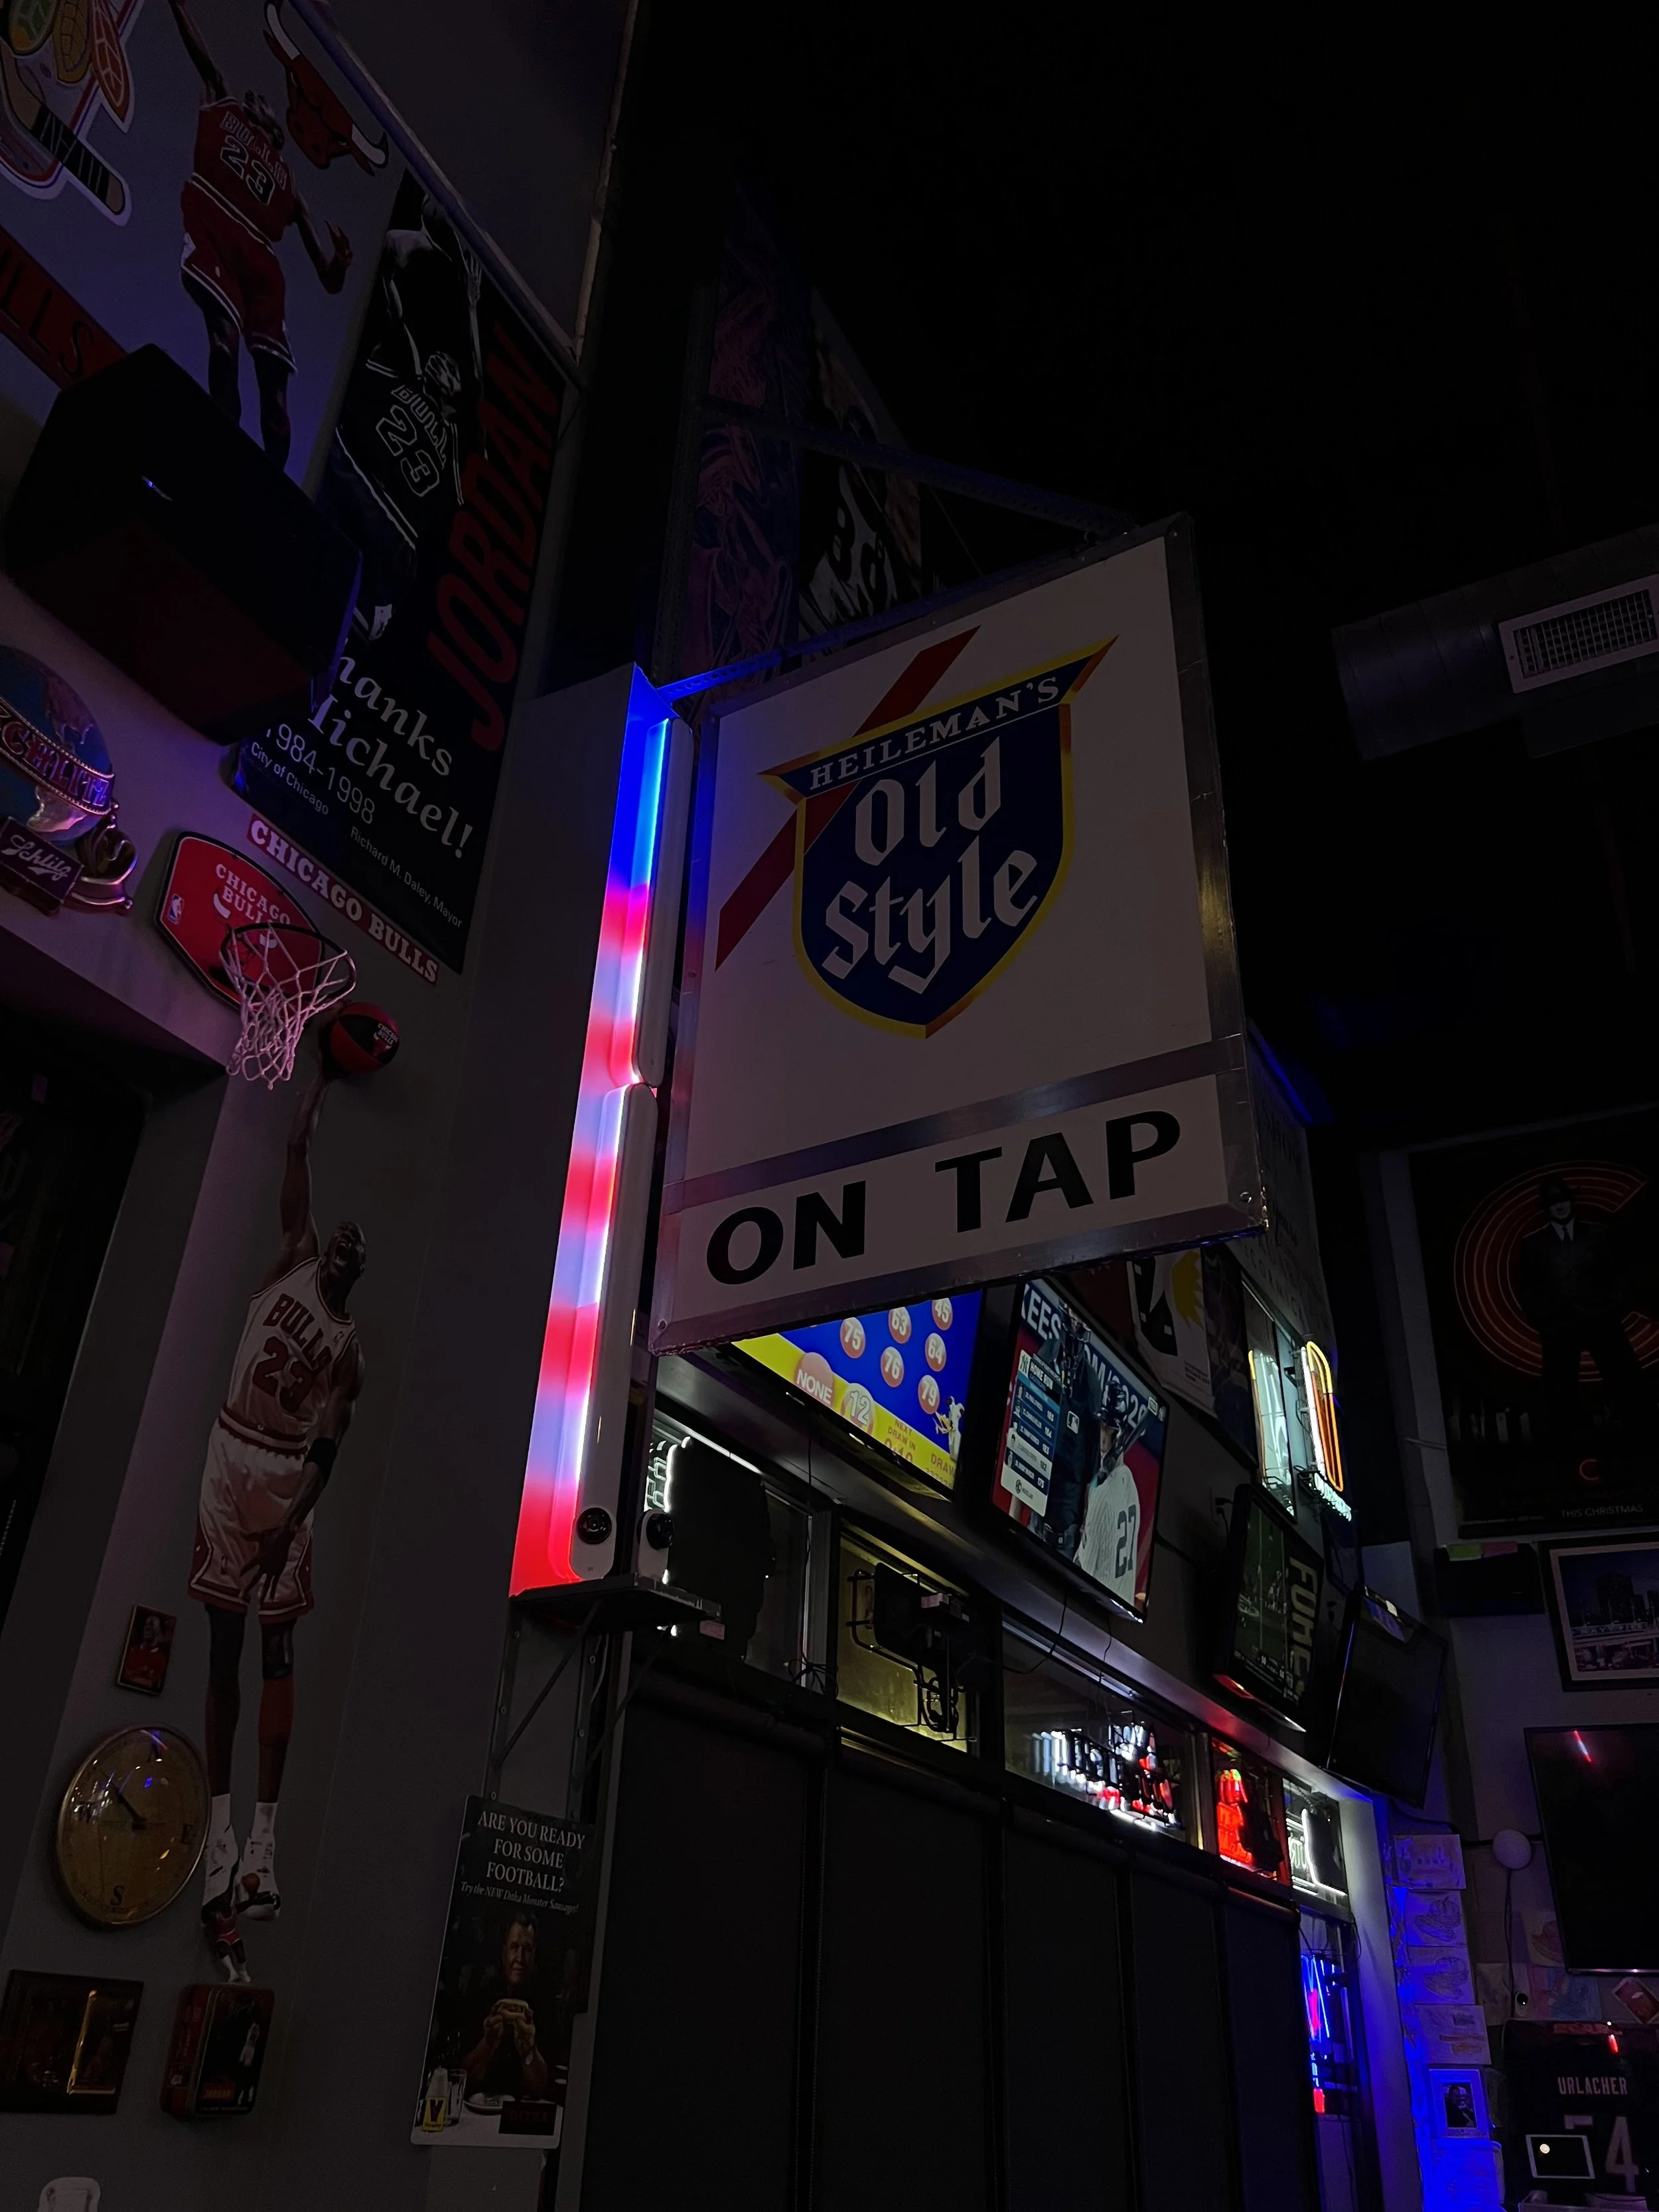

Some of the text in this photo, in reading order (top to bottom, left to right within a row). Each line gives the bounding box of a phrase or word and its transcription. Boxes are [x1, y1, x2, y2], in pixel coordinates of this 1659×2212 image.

[220, 135, 275, 206] 23
[376, 404, 441, 498] 23
[427, 319, 561, 751] JORDAN
[810, 676, 1060, 792] HEILEMAN'S
[251, 741, 329, 815] City of Chicago
[855, 735, 1001, 866] Old
[215, 863, 291, 924] CHICAGO
[350, 826, 463, 929] Richard M. Daley, Mayor
[251, 820, 438, 983] CHICAGO BULLS
[821, 834, 1039, 995] Style
[706, 1179, 866, 1285] ON
[935, 1110, 1181, 1234] TAP
[891, 1307, 907, 1336] 63
[934, 1298, 949, 1323] 45
[844, 1318, 861, 1351] 75
[928, 1337, 943, 1365] 64
[252, 1336, 315, 1413] 23
[885, 1348, 901, 1380] 76
[796, 1368, 833, 1405] NONE
[921, 1380, 936, 1407] 79
[849, 1390, 871, 1426] 12
[888, 1426, 916, 1451] DRAW IN
[895, 1418, 913, 1436] NEXT
[1561, 1503, 1644, 1519] THIS CHRISTMAS
[1115, 1504, 1137, 1579] 27
[478, 1810, 586, 1850] ARE YOU READY
[494, 1838, 565, 1869] FOR SOME
[461, 1880, 474, 1896] Try
[474, 1883, 485, 1895] the
[484, 1886, 504, 1899] NEW
[486, 1861, 565, 1893] FOOTBALL?
[110, 1885, 125, 1906] S
[1557, 2076, 1628, 2095] URLACHER
